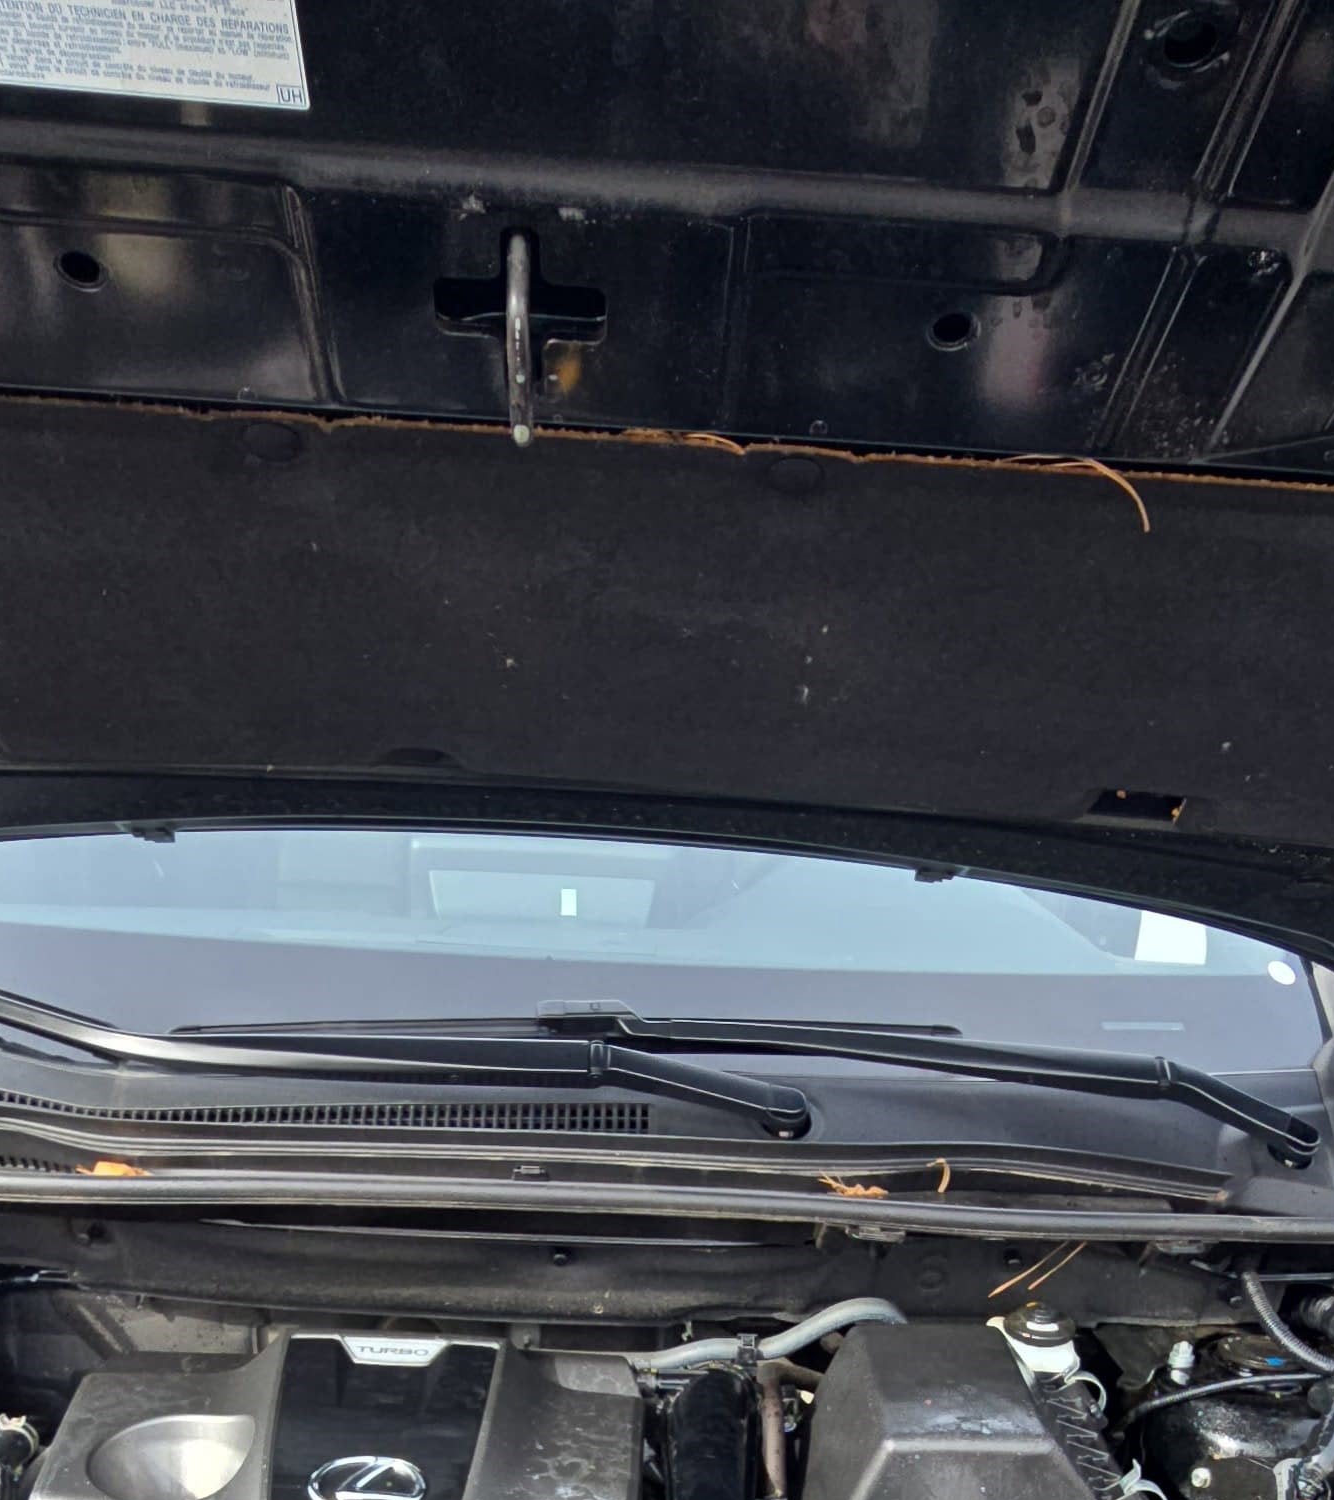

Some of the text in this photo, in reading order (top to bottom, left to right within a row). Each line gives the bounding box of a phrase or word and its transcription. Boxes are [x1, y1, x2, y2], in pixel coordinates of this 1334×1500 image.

[131, 10, 144, 22] EN
[150, 12, 191, 27] CHARGE
[196, 16, 216, 28] DES
[280, 87, 303, 103] UH
[355, 1345, 429, 1357] TURBO
